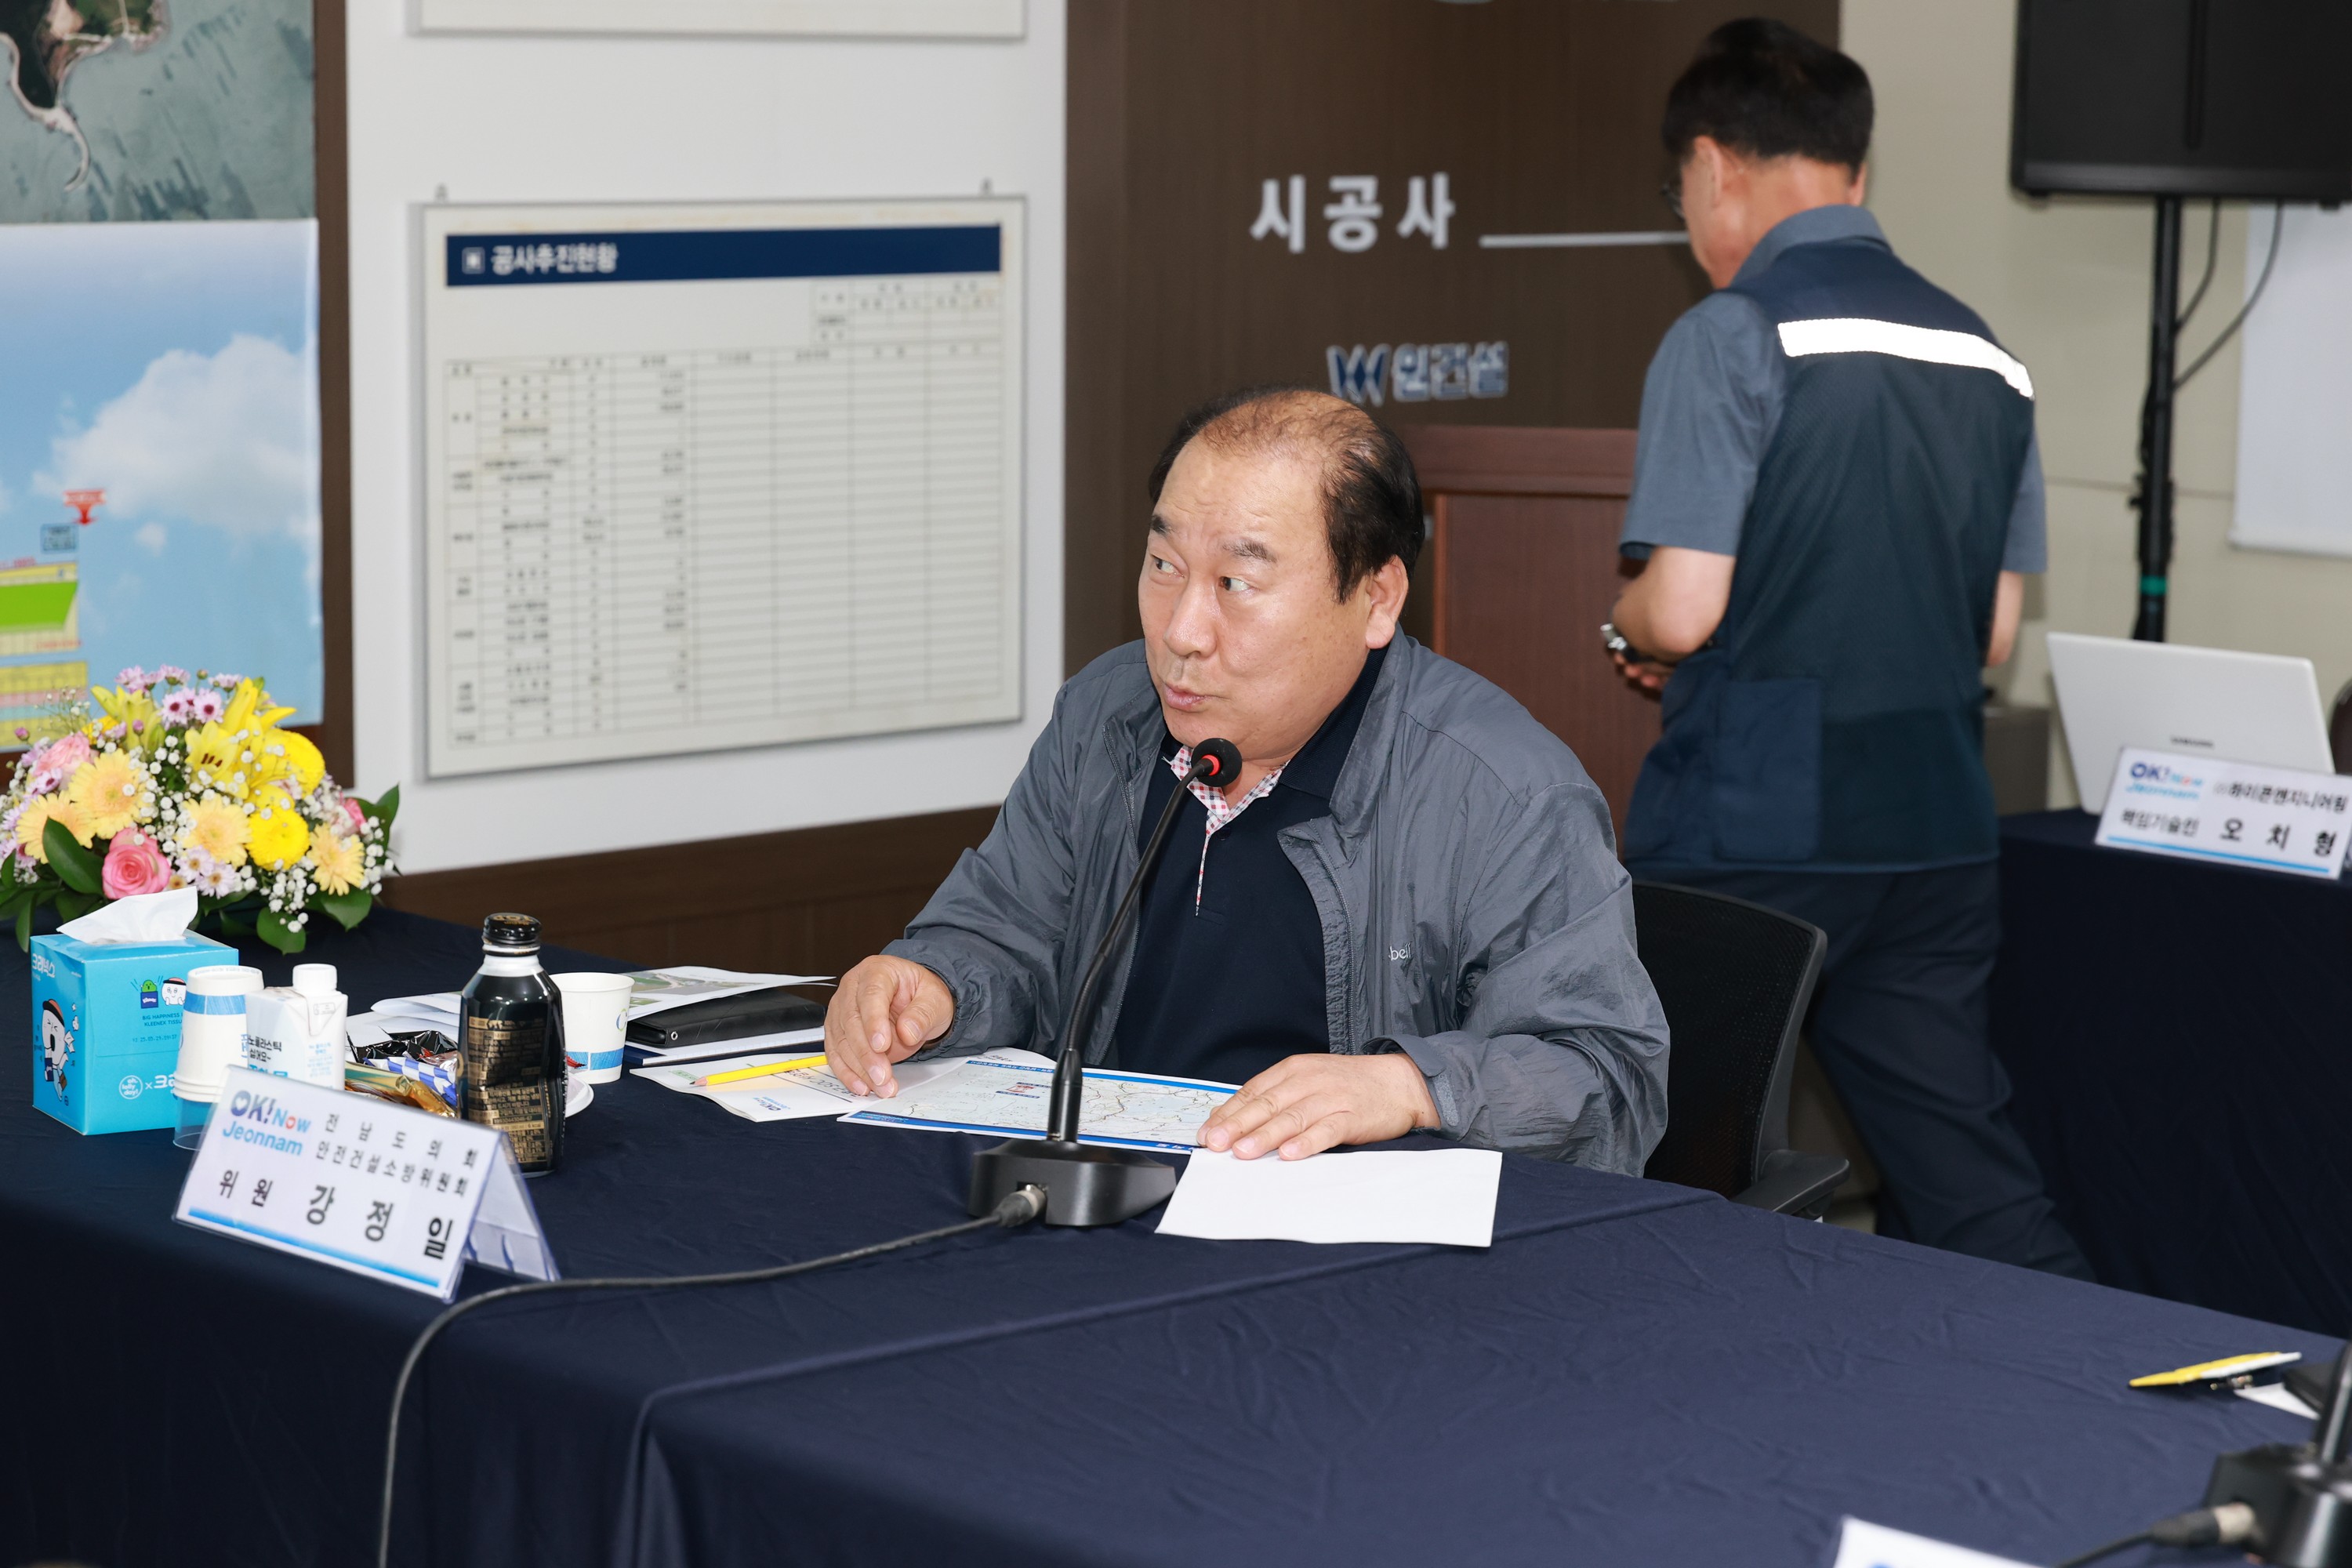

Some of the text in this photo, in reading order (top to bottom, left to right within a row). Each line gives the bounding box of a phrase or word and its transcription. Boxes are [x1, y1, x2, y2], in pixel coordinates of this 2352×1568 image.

[1250, 171, 1456, 253] 시공사
[491, 241, 619, 276] 공사추진현황
[230, 1090, 311, 1133] OK! Now
[223, 1120, 303, 1156] Jeonnam
